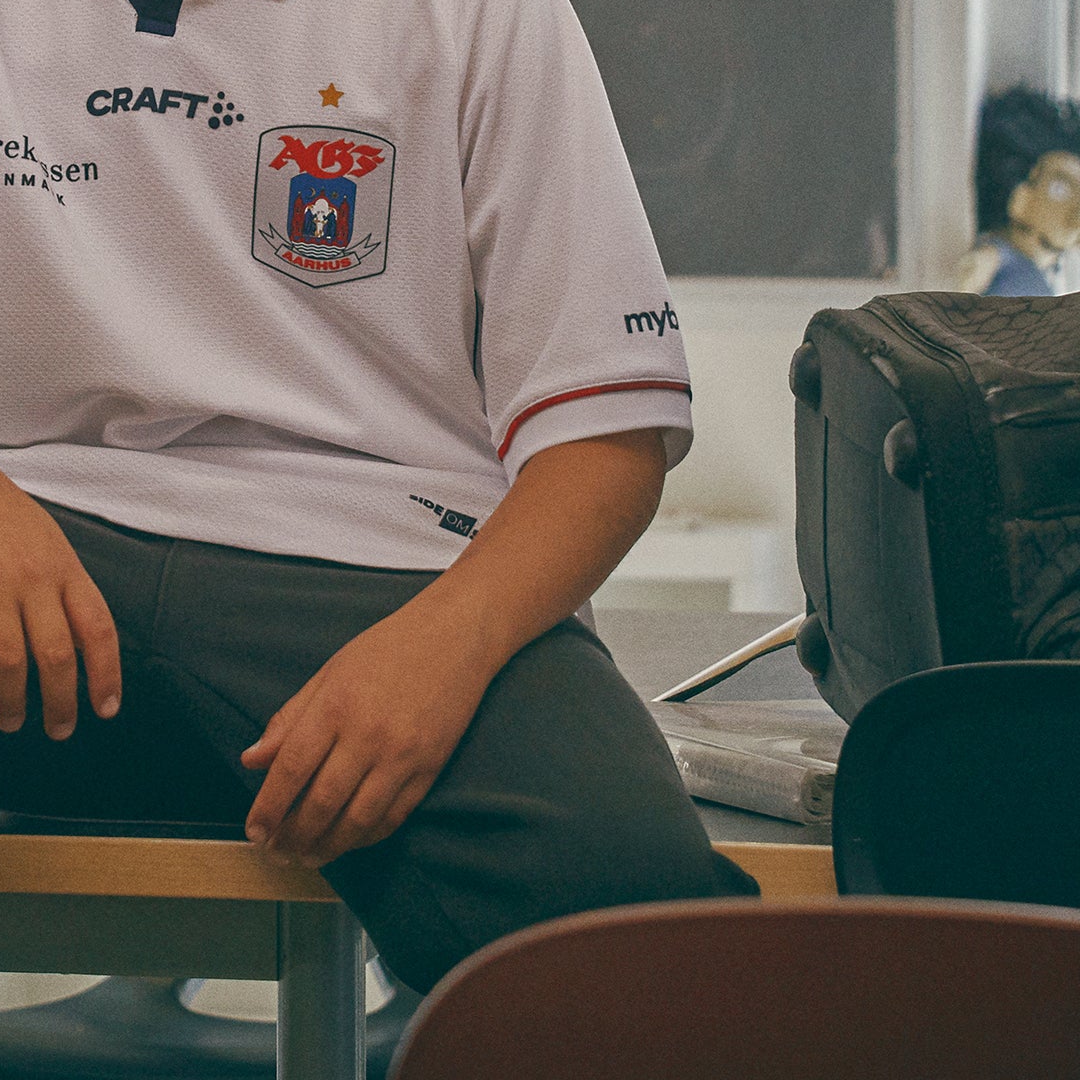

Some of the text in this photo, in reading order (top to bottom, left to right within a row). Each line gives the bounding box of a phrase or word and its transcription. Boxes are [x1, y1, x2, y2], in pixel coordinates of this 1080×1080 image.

[86, 87, 209, 119] CRAFT
[281, 251, 352, 271] AARHUS
[623, 301, 679, 337] myb
